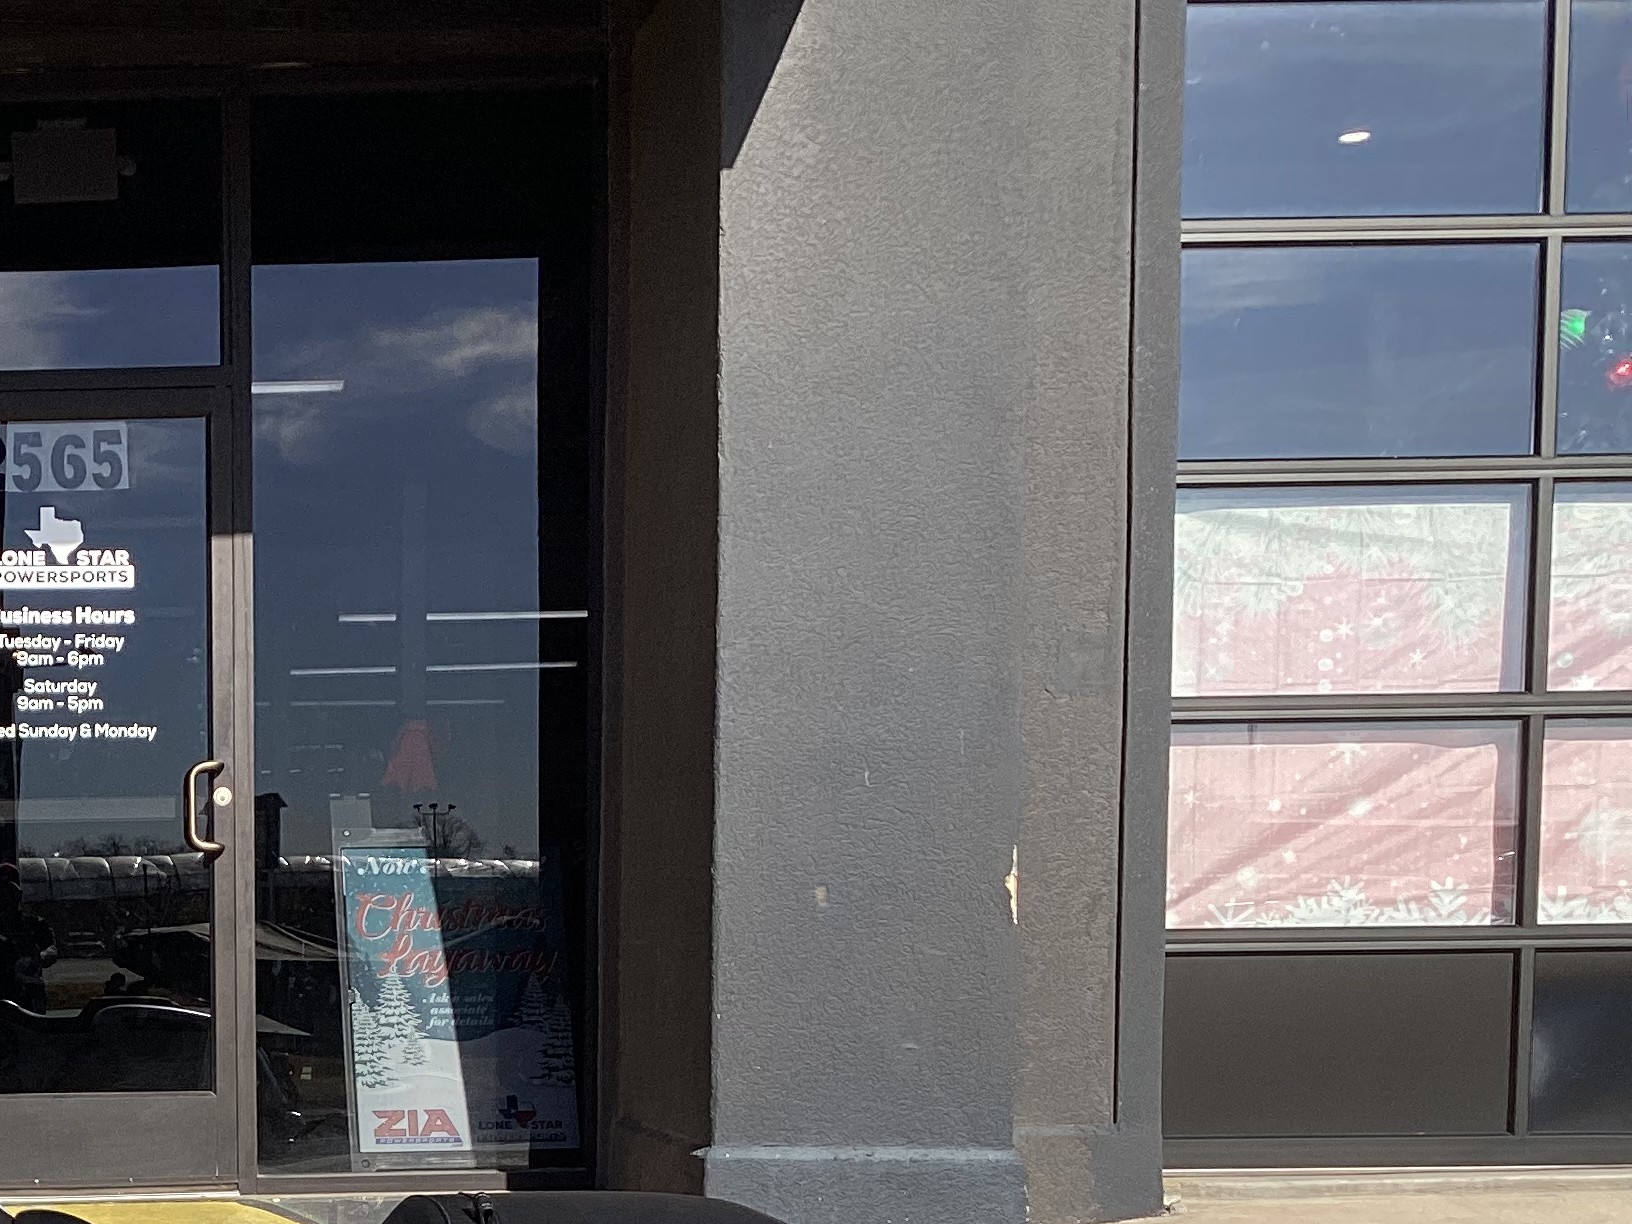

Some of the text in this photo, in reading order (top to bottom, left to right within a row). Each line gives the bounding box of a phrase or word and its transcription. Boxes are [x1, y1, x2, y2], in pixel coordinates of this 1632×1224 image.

[76, 550, 129, 566] STAR
[75, 606, 136, 625] Hours
[75, 633, 125, 651] Friday
[17, 651, 54, 666] 9am
[67, 651, 104, 669] 6pm
[24, 678, 98, 696] Saturday
[17, 696, 54, 710] 9am
[67, 696, 104, 713] 5pm
[18, 723, 78, 741] Sunday
[79, 723, 93, 738] &
[94, 723, 158, 741] Monday
[357, 855, 420, 877] Now
[371, 1108, 460, 1137] ZIA
[478, 1119, 563, 1130] LONE STAR
